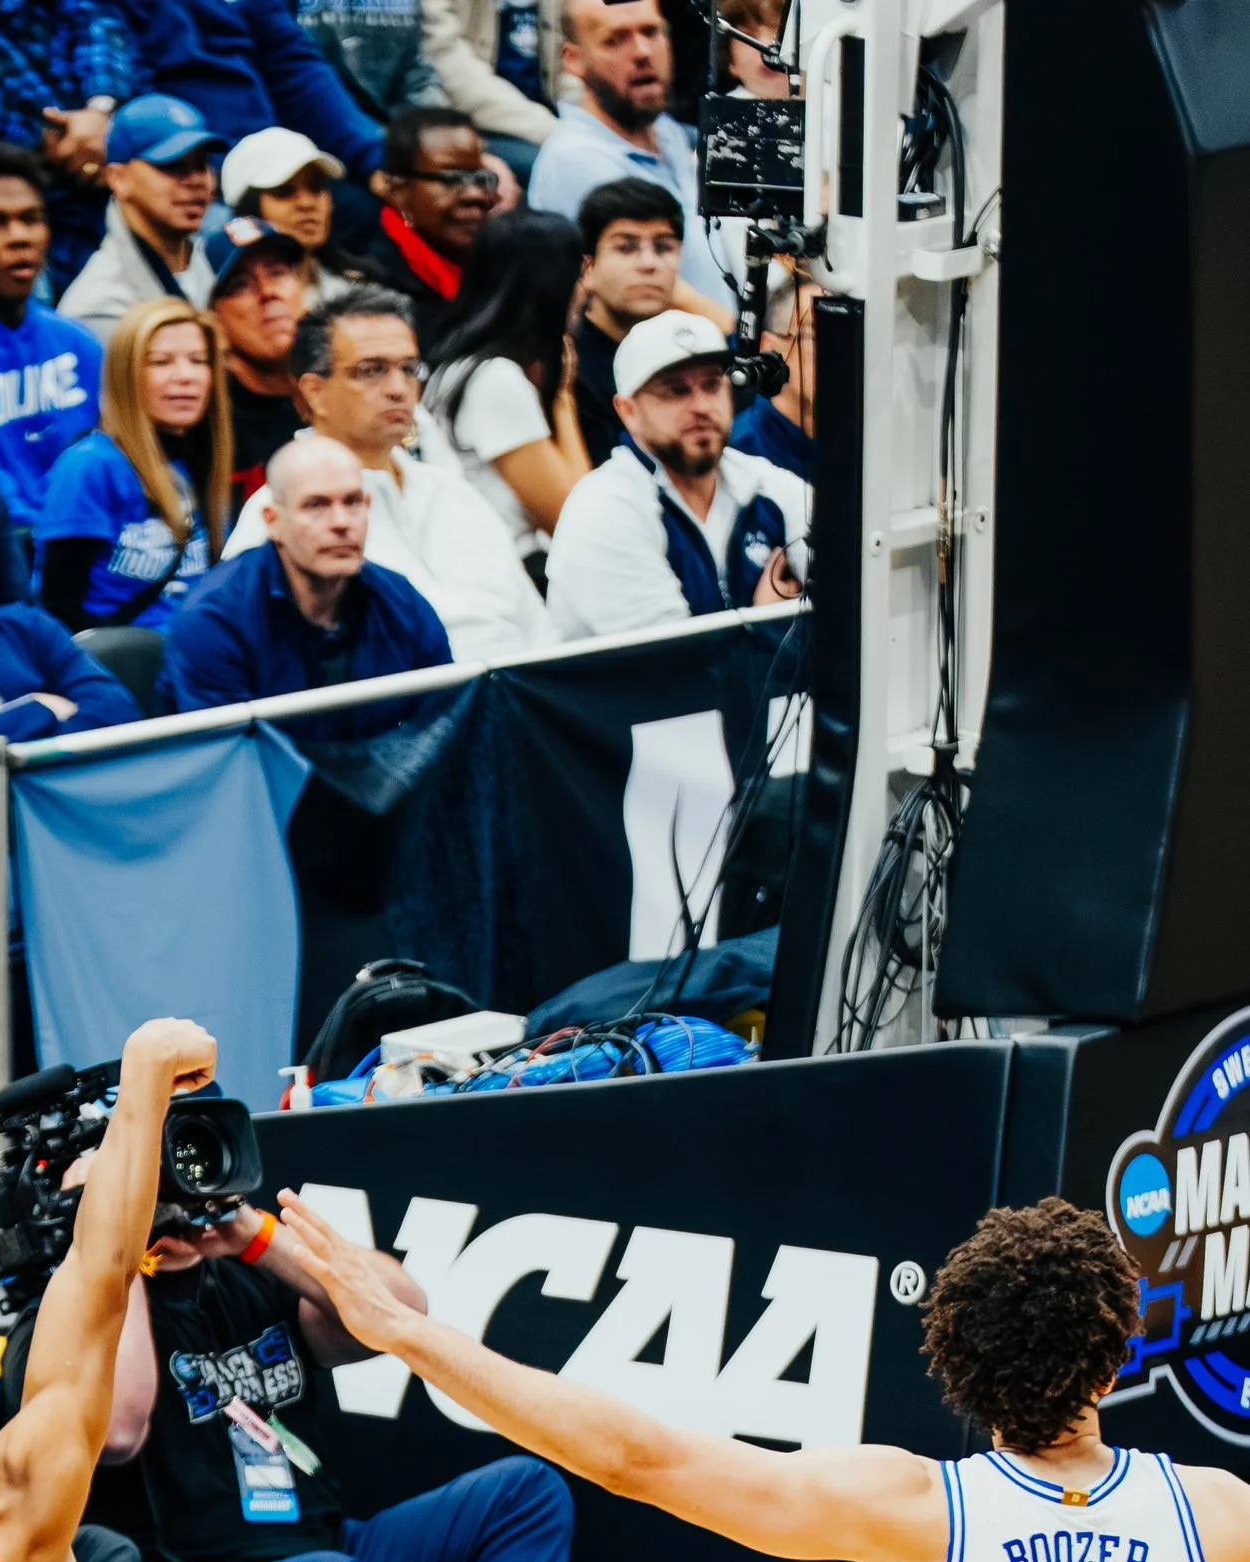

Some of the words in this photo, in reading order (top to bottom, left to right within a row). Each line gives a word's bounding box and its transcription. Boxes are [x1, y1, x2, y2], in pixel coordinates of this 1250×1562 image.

[1127, 1187, 1173, 1219] NCAA
[298, 1182, 879, 1450] NCAA
[1201, 1224, 1250, 1321] M
